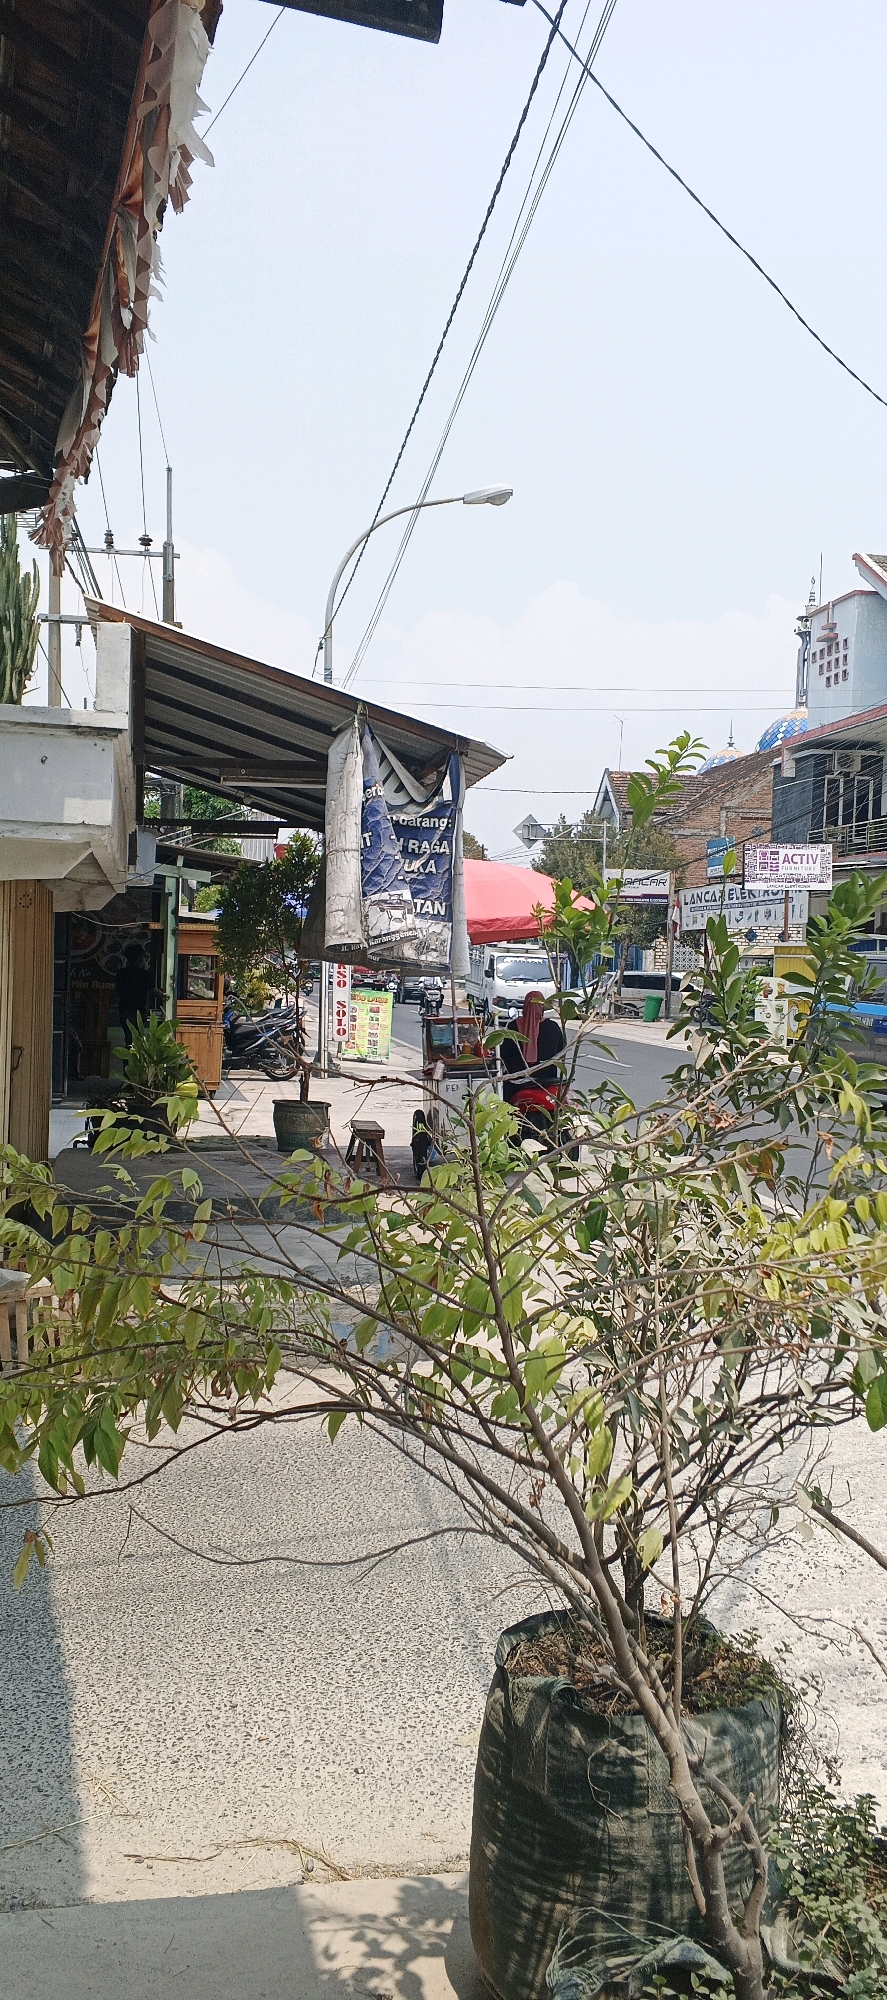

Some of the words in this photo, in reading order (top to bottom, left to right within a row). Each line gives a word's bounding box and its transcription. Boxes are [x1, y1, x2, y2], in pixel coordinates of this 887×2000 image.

[408, 838, 451, 855] RAGA
[782, 853, 819, 865] ACTIV
[336, 1001, 347, 1036] SOLO
